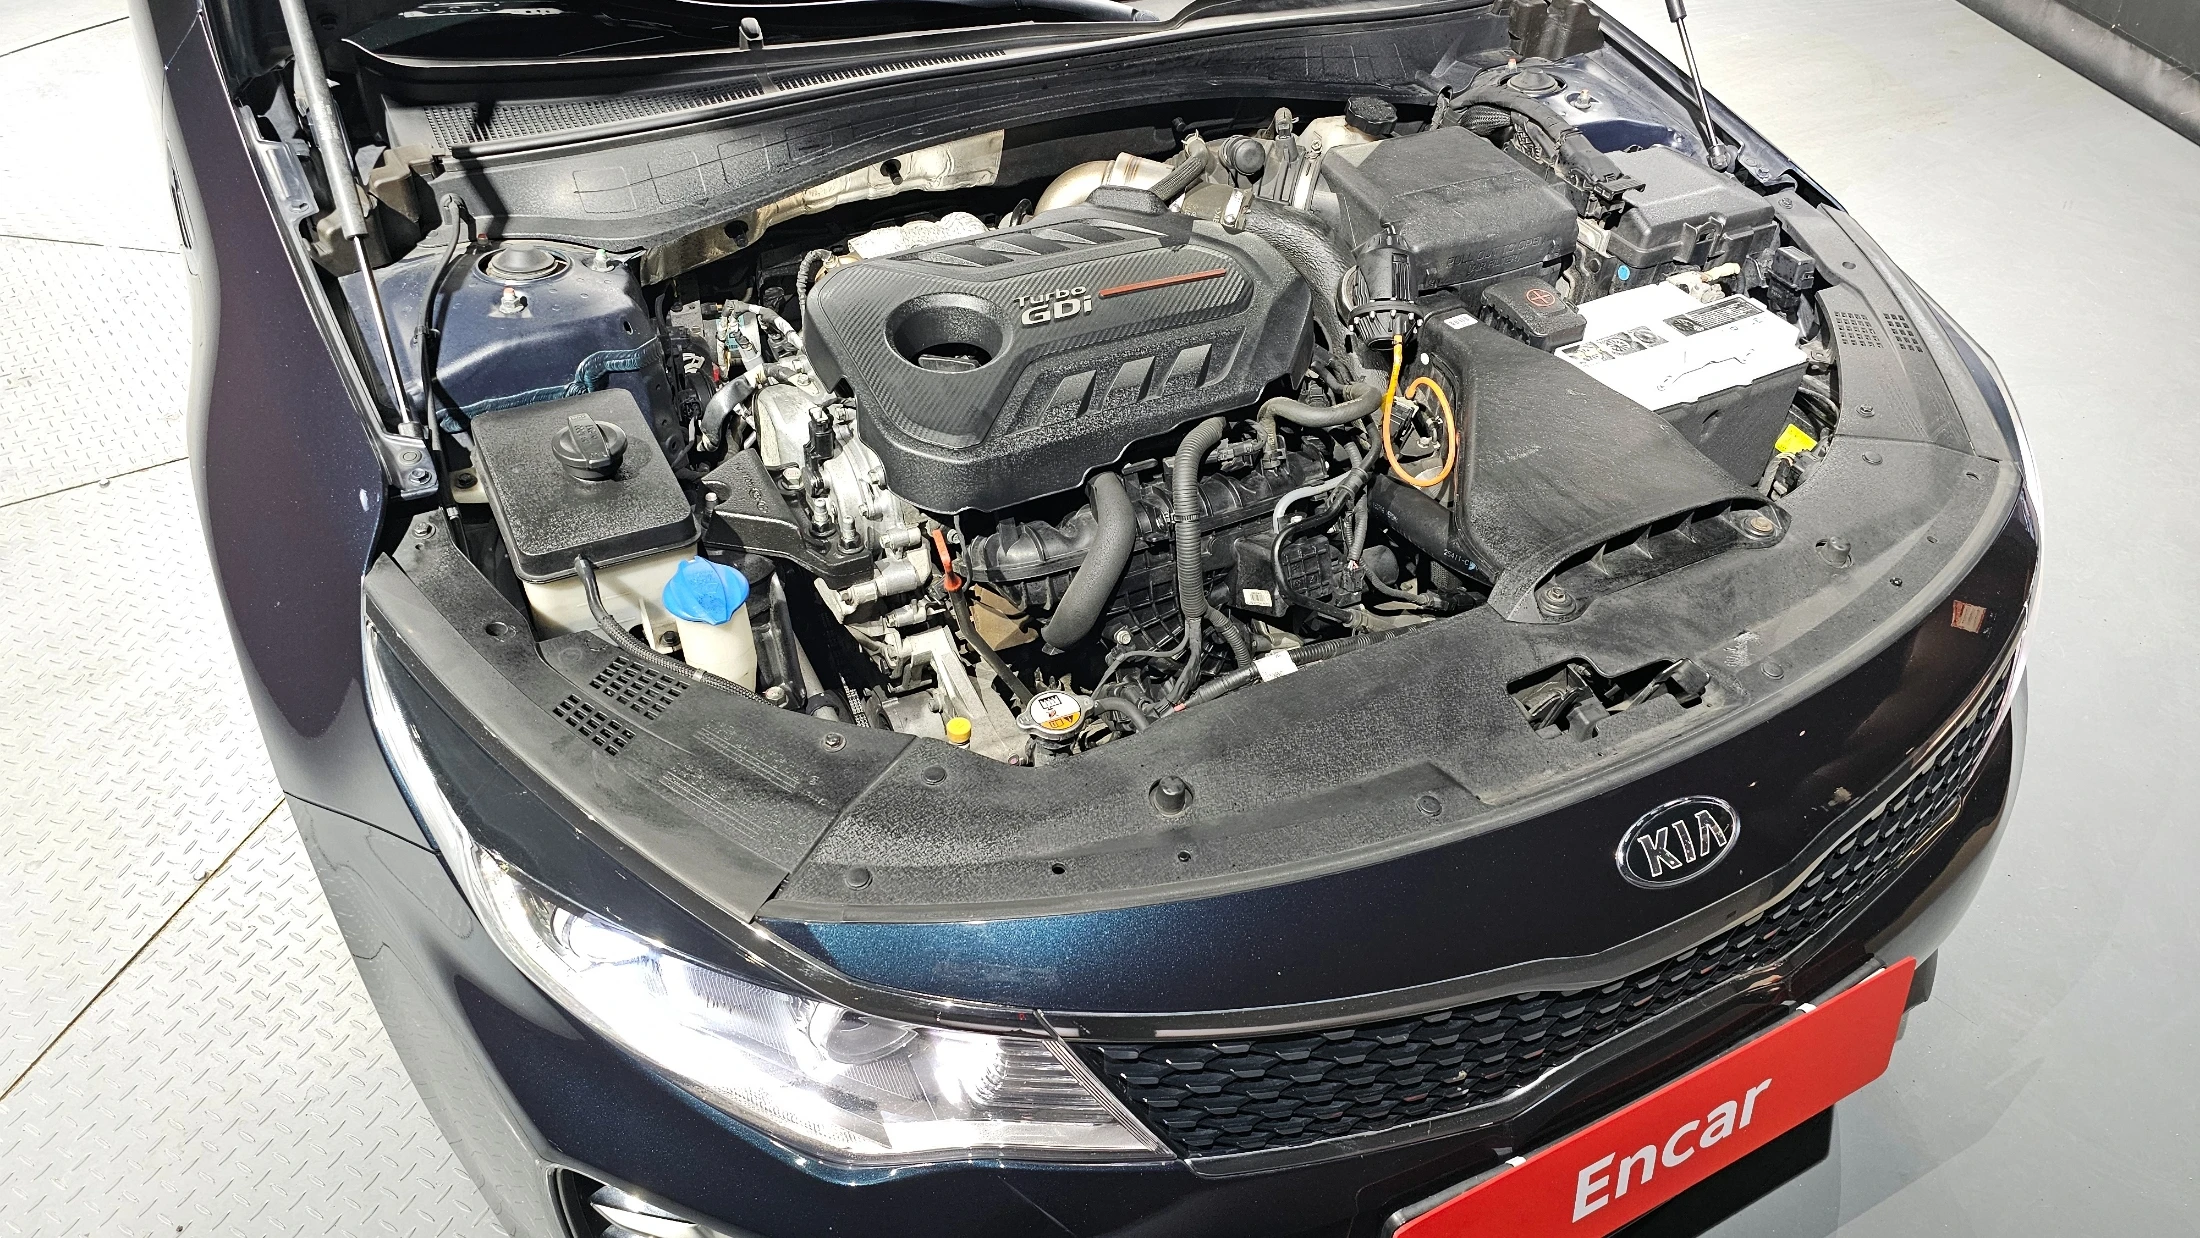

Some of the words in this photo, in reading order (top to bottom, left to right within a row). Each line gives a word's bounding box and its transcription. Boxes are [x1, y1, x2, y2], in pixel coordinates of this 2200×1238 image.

[1446, 253, 1473, 269] PULL
[1477, 247, 1500, 261] OUT
[1016, 286, 1087, 308] Turbo
[1021, 295, 1092, 326] GDi
[1637, 809, 1727, 877] KIA
[1571, 1078, 1773, 1224] Encar
